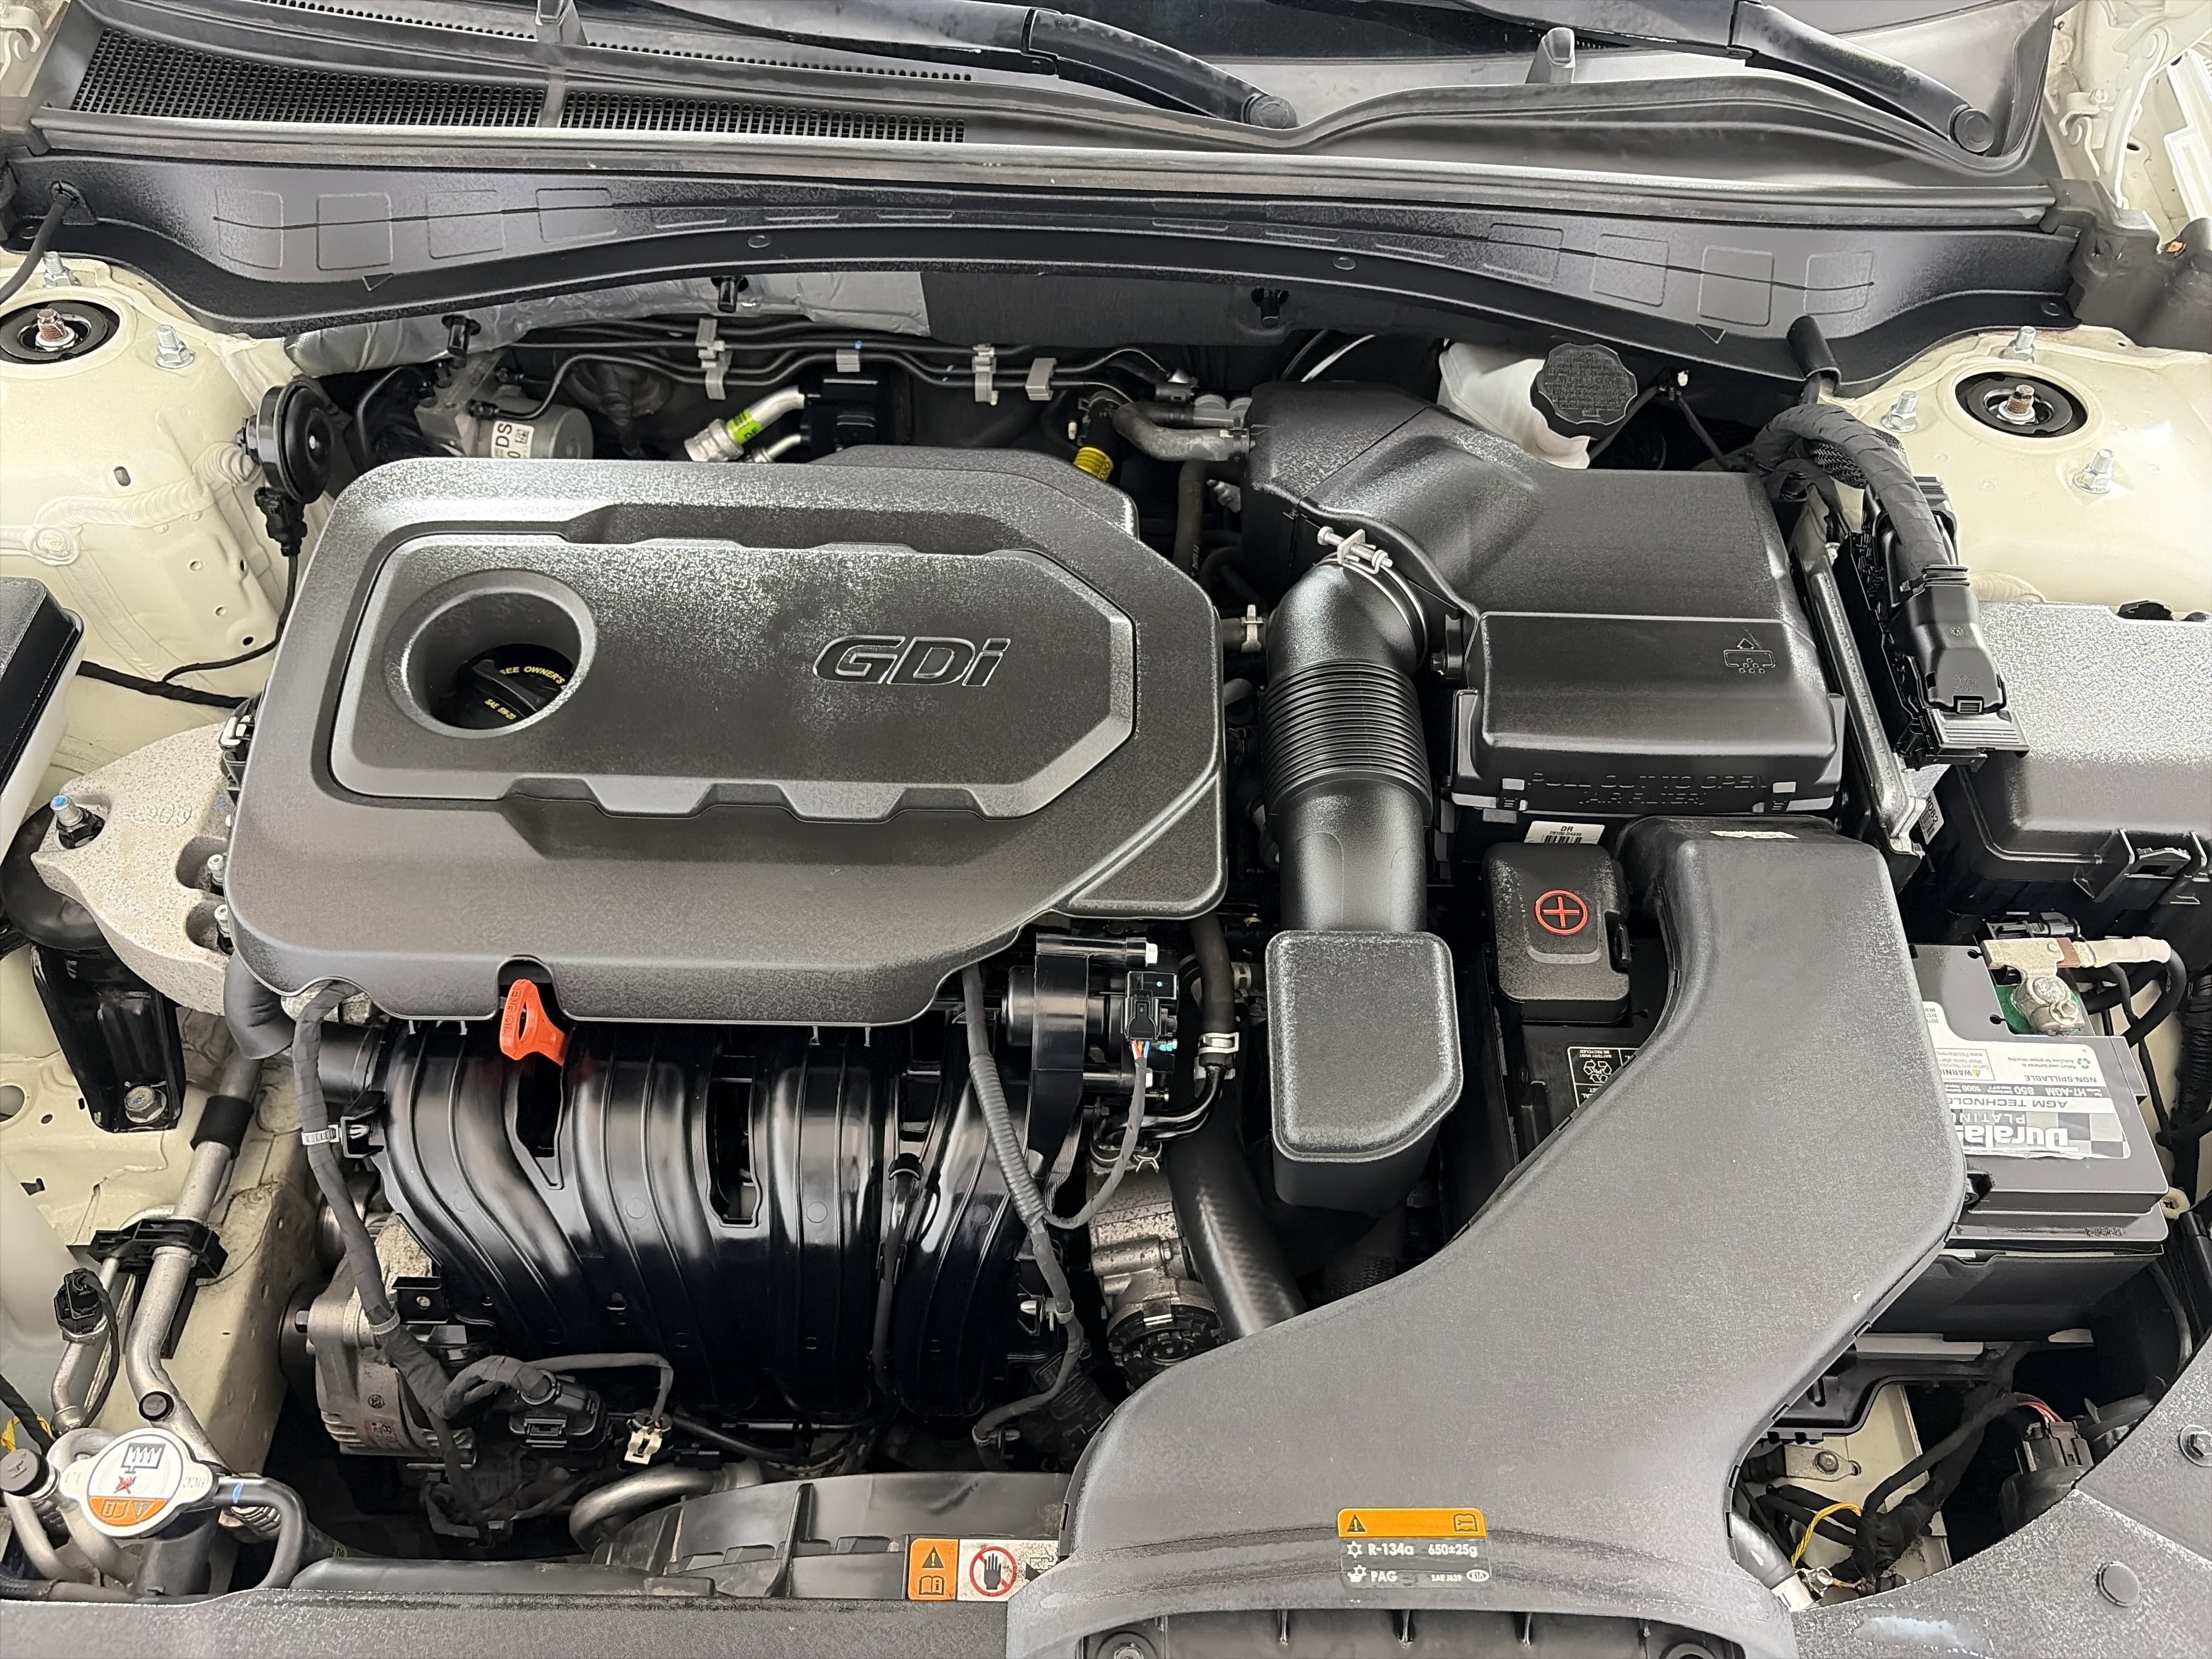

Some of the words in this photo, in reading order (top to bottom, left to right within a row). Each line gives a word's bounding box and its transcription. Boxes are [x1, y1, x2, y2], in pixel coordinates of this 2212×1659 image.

[813, 635, 1011, 686] GDi
[499, 667, 520, 675] SEE
[523, 666, 566, 684] OWNER'S
[484, 699, 500, 709] SAE
[1528, 773, 1592, 787] PULL
[1601, 775, 1656, 788] OUT
[1662, 775, 1691, 788] TO
[1701, 775, 1767, 788] OPEN
[507, 989, 521, 1012] ENG
[502, 1015, 514, 1037] OIL
[2014, 1086, 2034, 1094] 850
[2045, 1087, 2087, 1096] H7-AGM
[2032, 1100, 2068, 1108] AGM
[1368, 1543, 1414, 1555] R-134a
[1428, 1544, 1477, 1558] 650±25g
[1371, 1571, 1397, 1582] PAG
